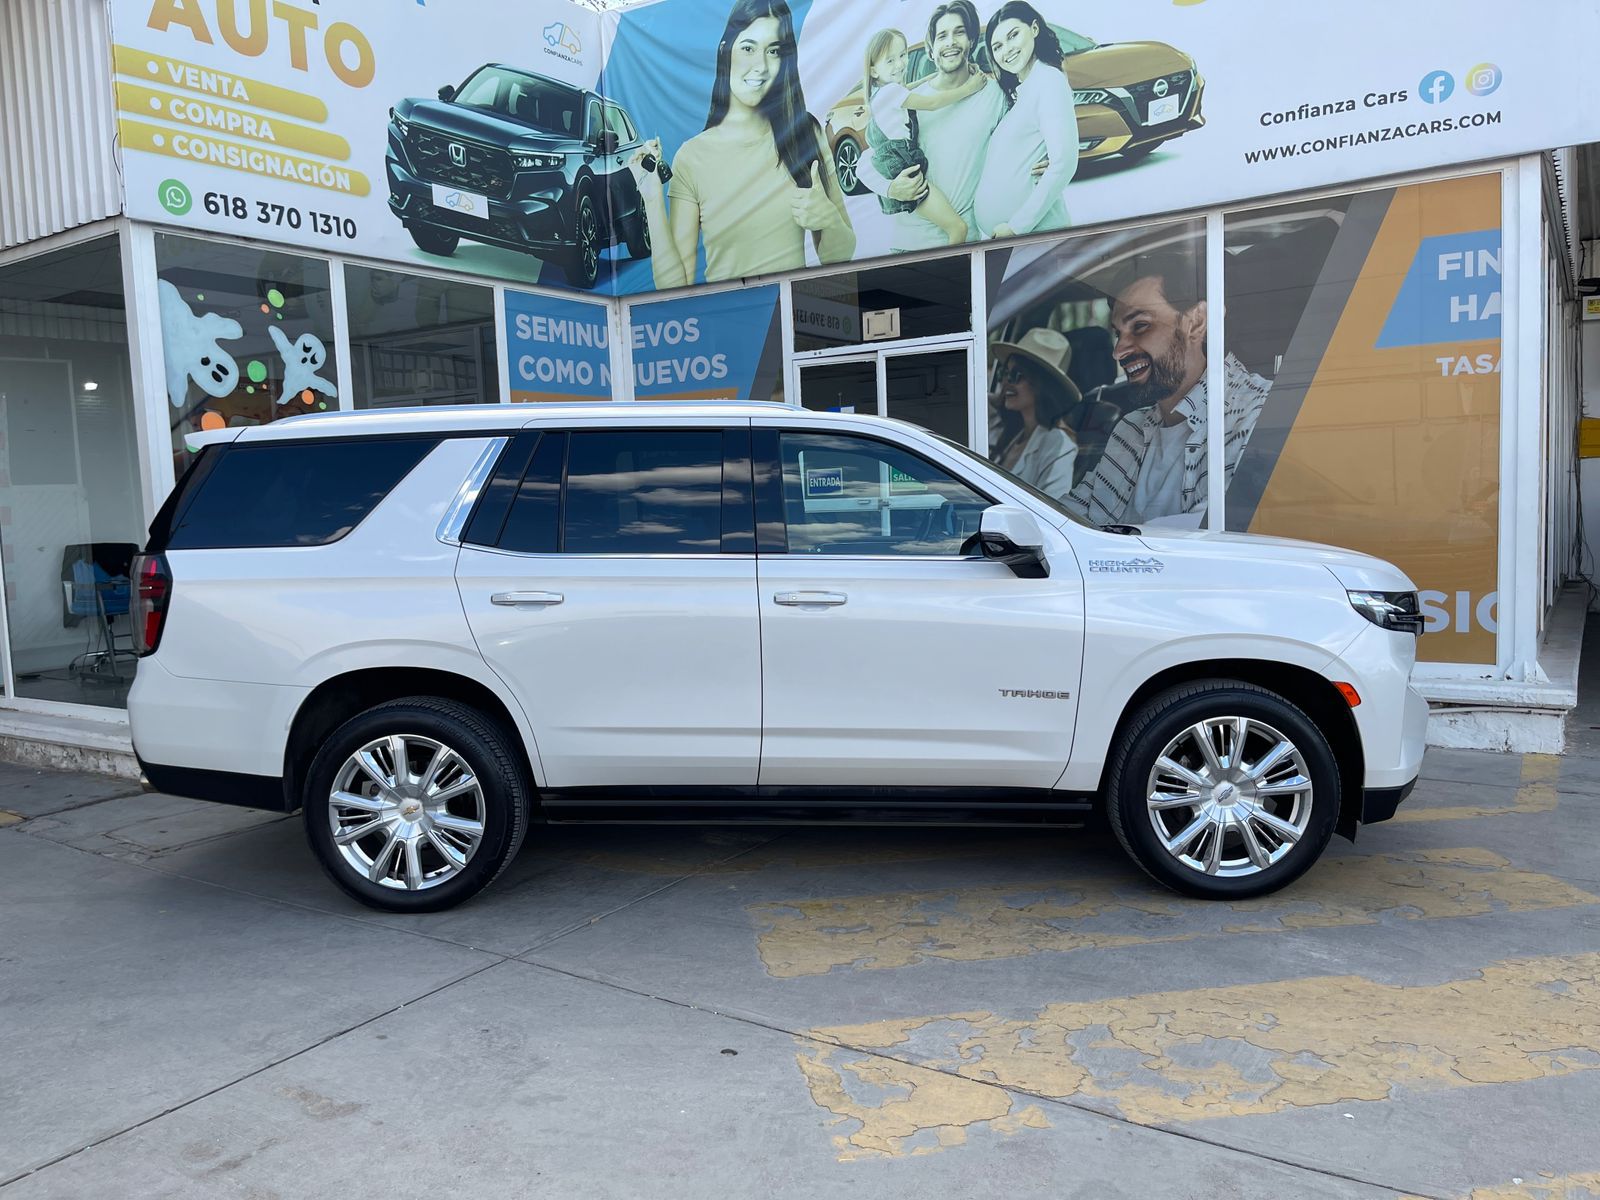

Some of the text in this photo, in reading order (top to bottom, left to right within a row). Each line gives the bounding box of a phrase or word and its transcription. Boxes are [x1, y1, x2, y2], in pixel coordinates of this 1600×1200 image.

[147, 0, 376, 88] AUTO
[166, 61, 249, 101] VENTA
[169, 98, 276, 141] COMPRA
[1259, 98, 1356, 127] Confianza
[1363, 88, 1408, 108] Cars
[1244, 110, 1502, 165] WWW.CONFIANZACARS.COM
[172, 134, 350, 191] CONSIGNACIÓN
[203, 191, 357, 239] 618 370 1310
[518, 354, 593, 386] COMO
[809, 476, 841, 488] ENTRADA
[1088, 559, 1126, 567] HIGH
[1088, 566, 1164, 574] COUNTRY
[998, 688, 1070, 700] TAHOE
